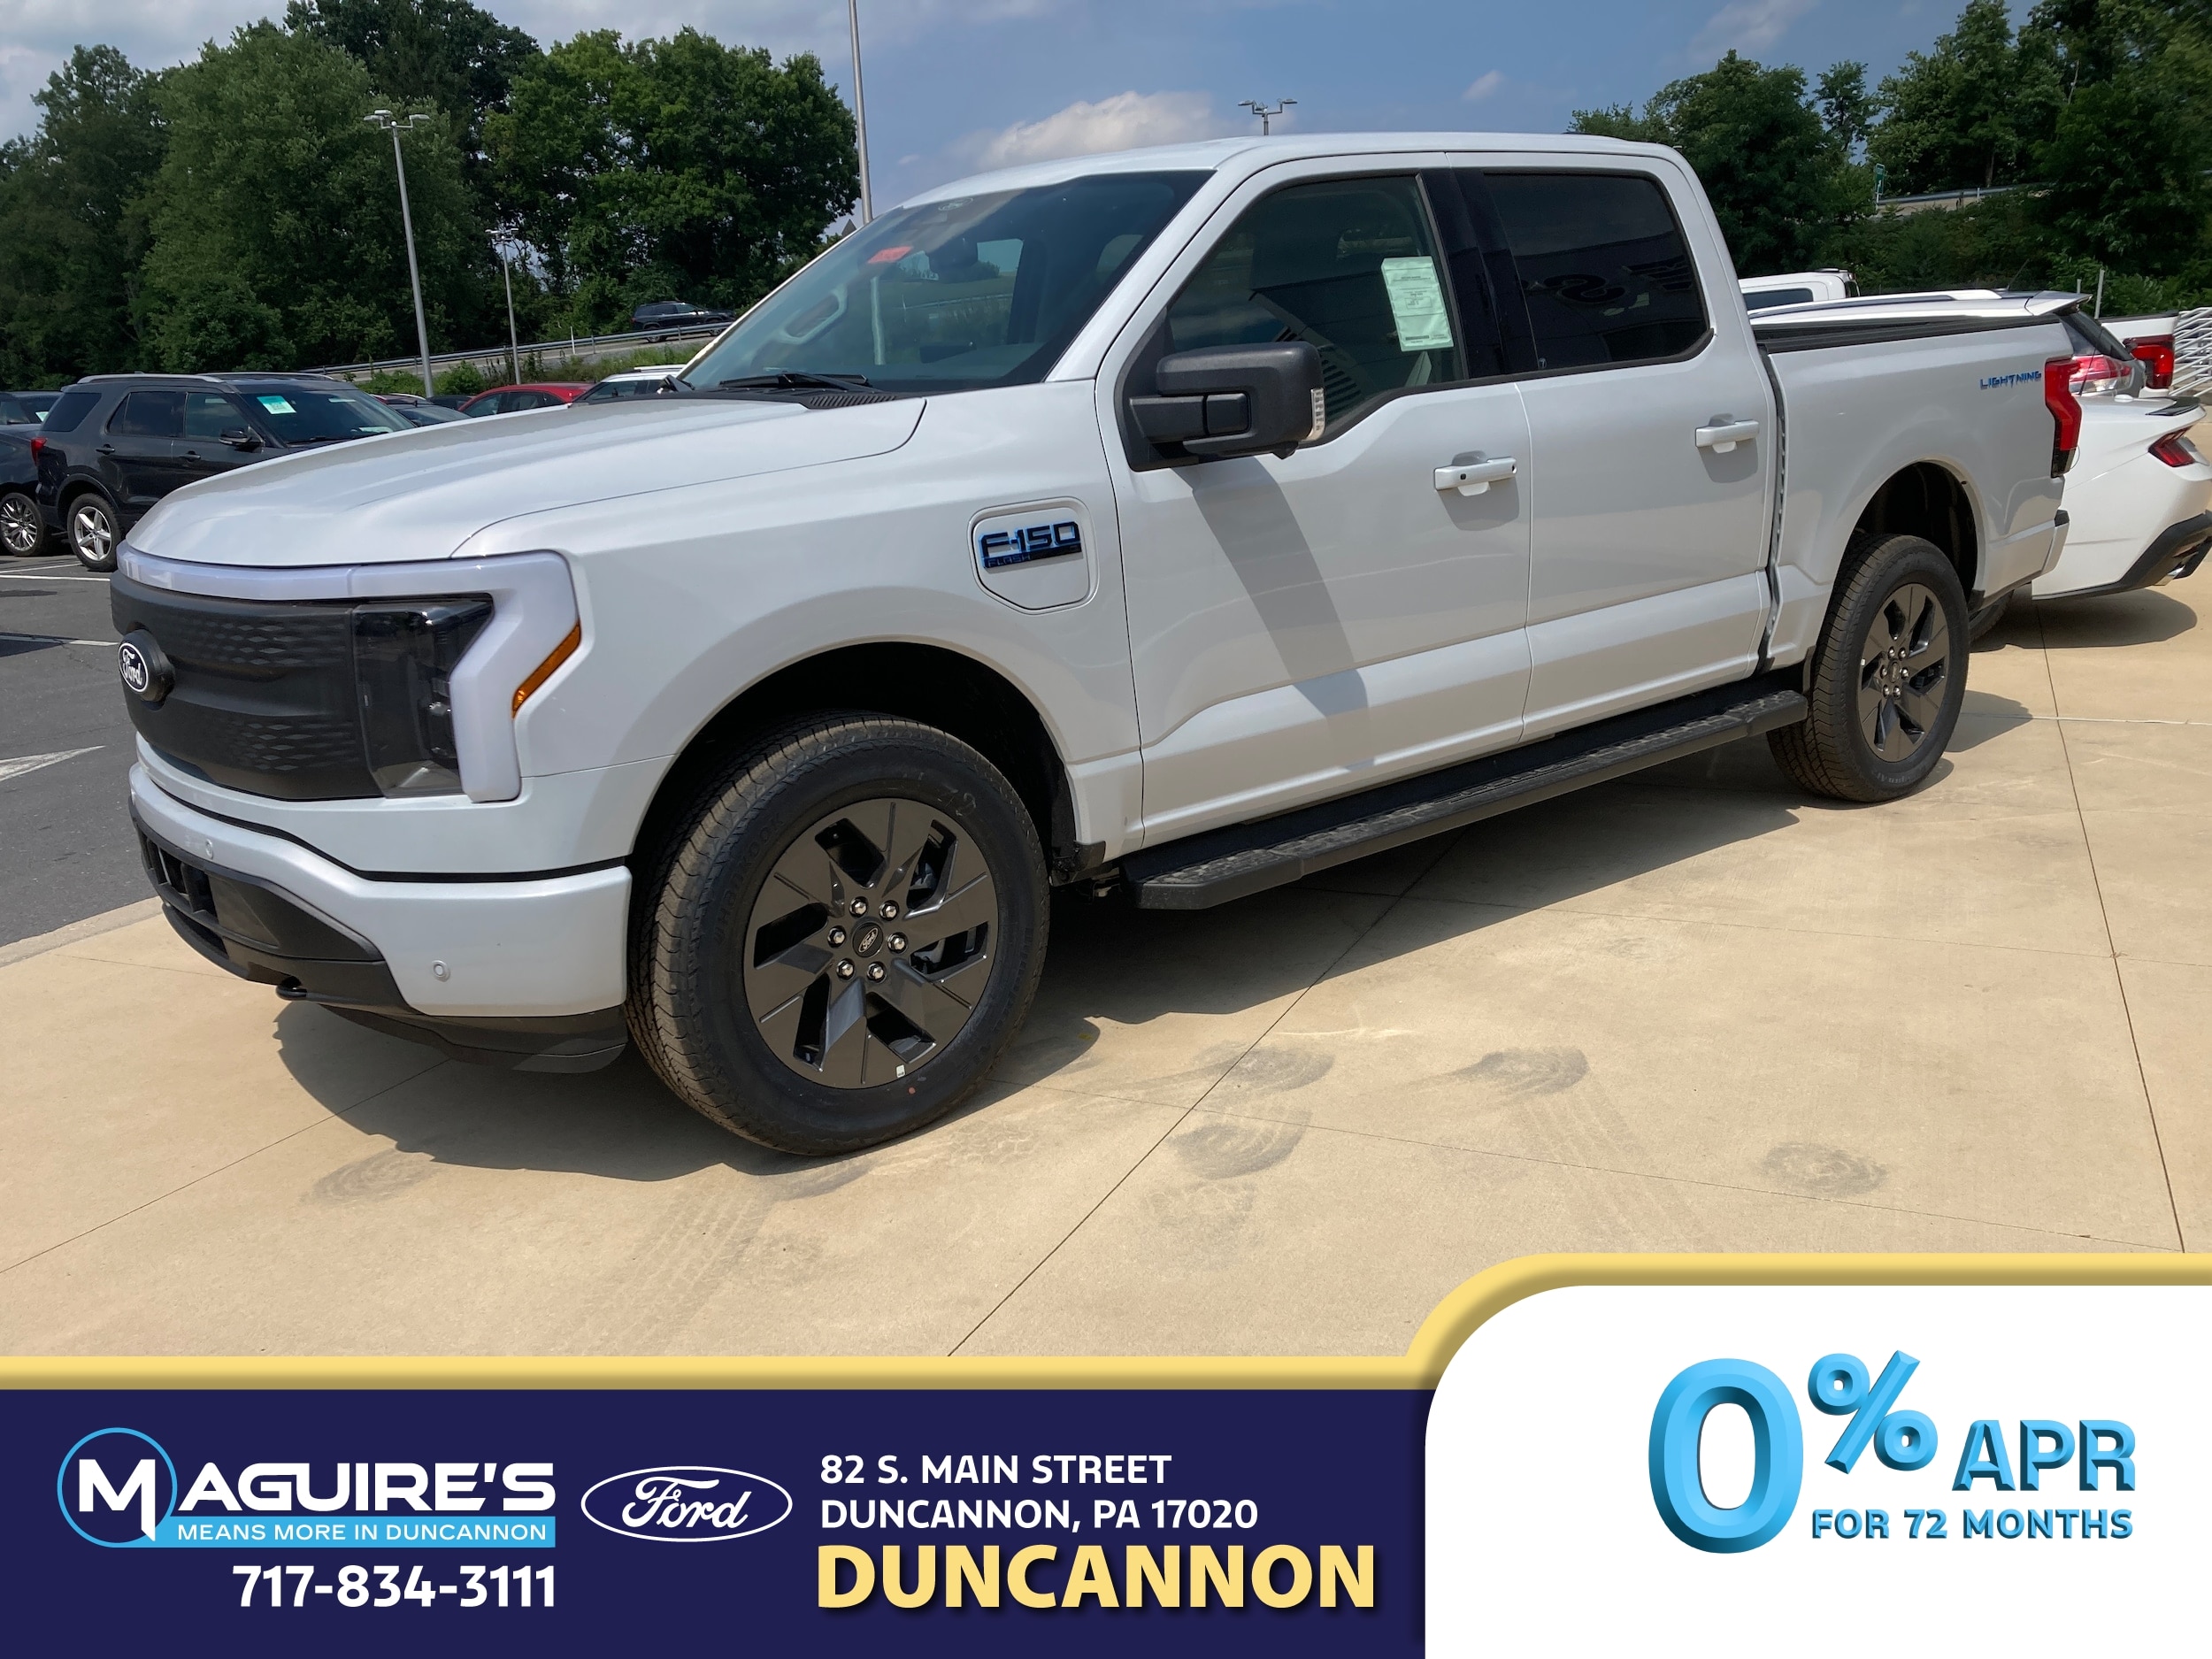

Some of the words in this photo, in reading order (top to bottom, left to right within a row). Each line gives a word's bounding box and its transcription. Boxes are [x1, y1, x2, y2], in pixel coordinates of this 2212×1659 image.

[1980, 370, 2042, 389] LIGHTNING
[979, 520, 1081, 561] F-150
[987, 553, 1032, 569] FLASH
[122, 648, 143, 687] Ford
